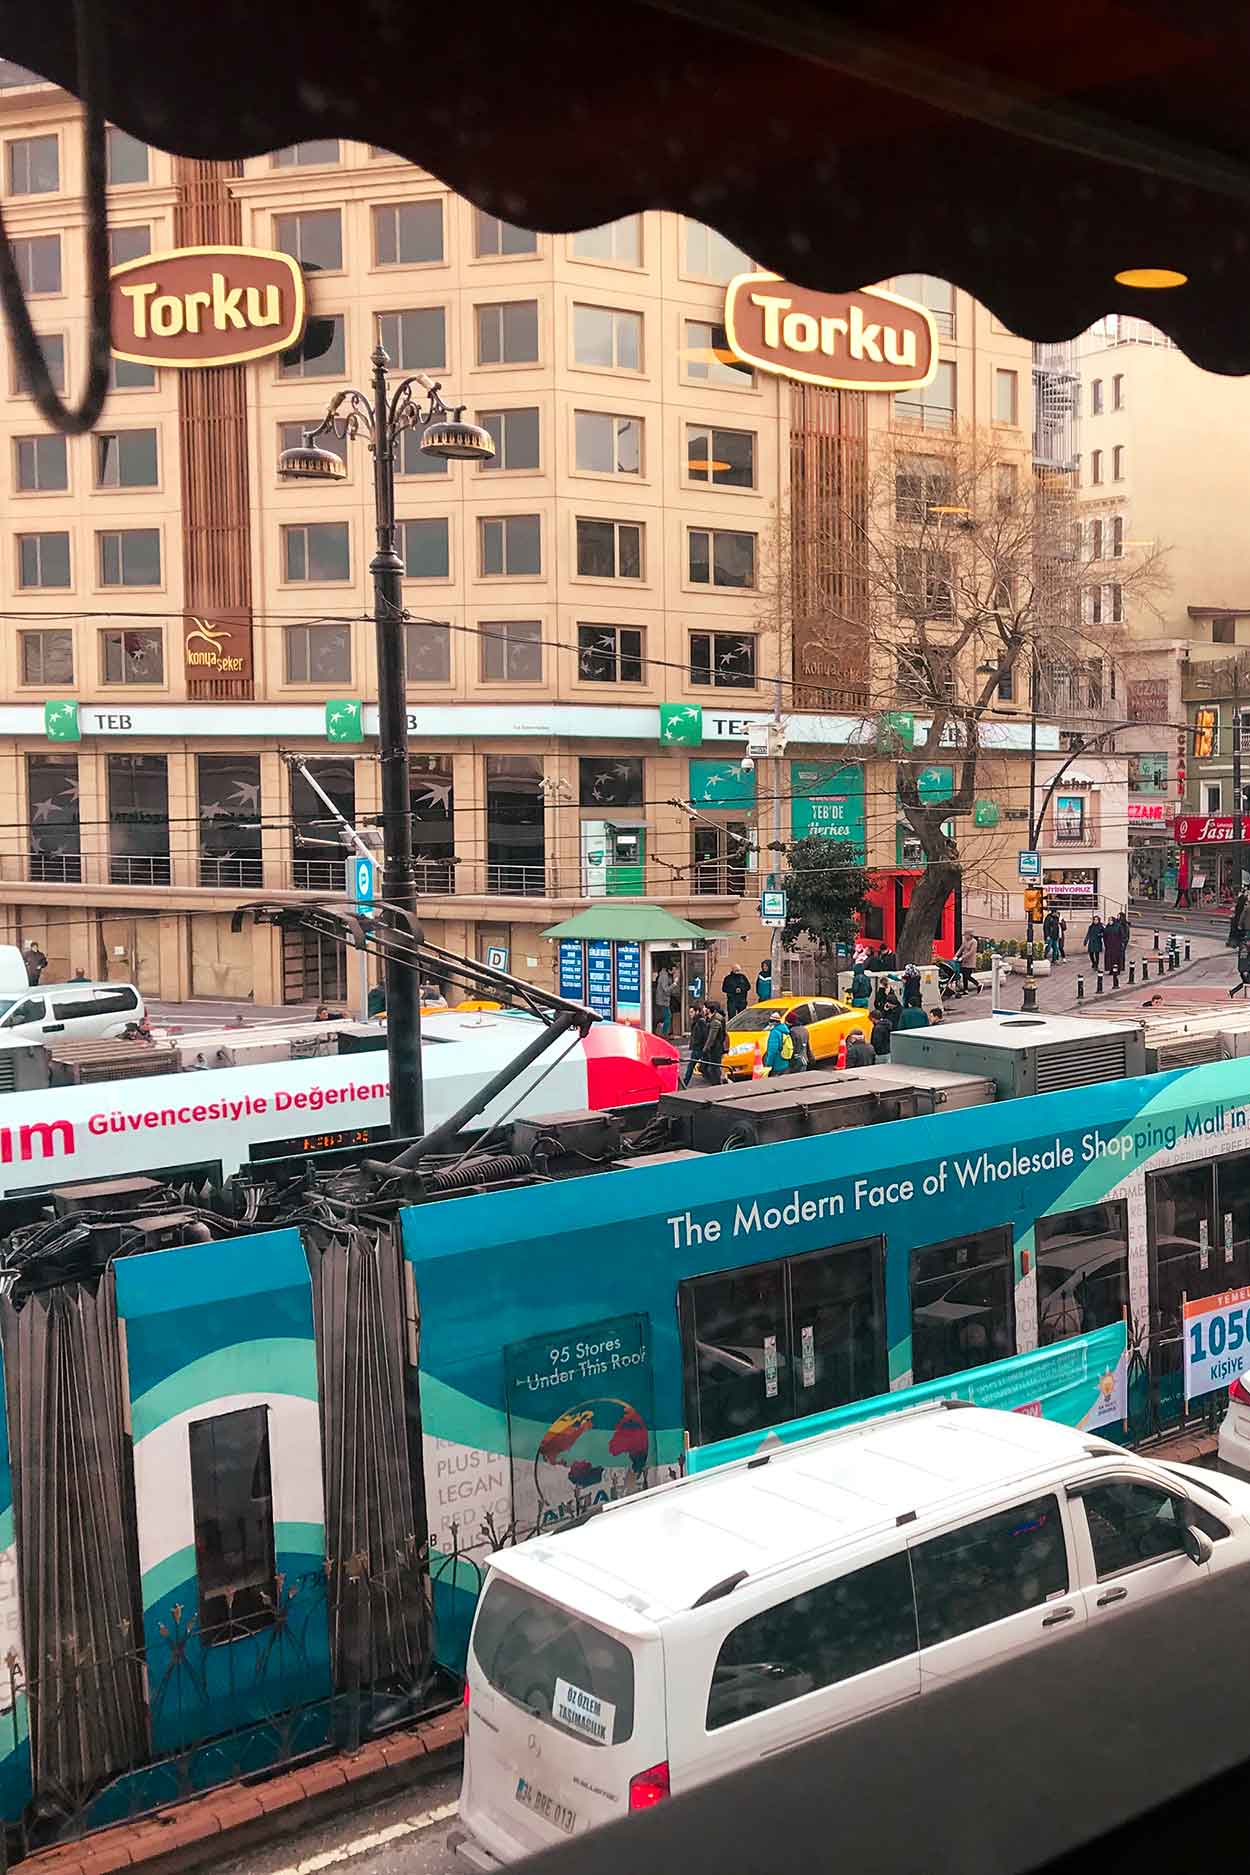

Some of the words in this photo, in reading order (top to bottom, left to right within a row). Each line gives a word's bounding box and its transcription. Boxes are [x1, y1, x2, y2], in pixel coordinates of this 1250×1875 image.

[119, 272, 282, 339] Torku
[750, 291, 918, 368] Torku
[188, 649, 217, 668] konya
[94, 713, 132, 730] TEB
[811, 805, 845, 820] TEB'DE
[87, 1090, 269, 1137] Güvencesiyle
[667, 1211, 722, 1249] The
[732, 1191, 845, 1238] Modern
[853, 1180, 914, 1211] Face
[922, 1163, 947, 1195] of
[952, 1140, 1075, 1190] Wholesale
[1081, 1119, 1177, 1162] Shopping
[1184, 1106, 1225, 1139] Mall
[1230, 1108, 1247, 1129] in
[548, 1347, 571, 1366] 95
[575, 1336, 621, 1362] Stores
[526, 1368, 575, 1392] Under
[578, 1357, 608, 1381] This
[610, 1345, 648, 1371] Roof
[1210, 1355, 1244, 1381] KİŞİYE
[437, 1450, 481, 1478] PLUS
[438, 1471, 503, 1505] LEGAN
